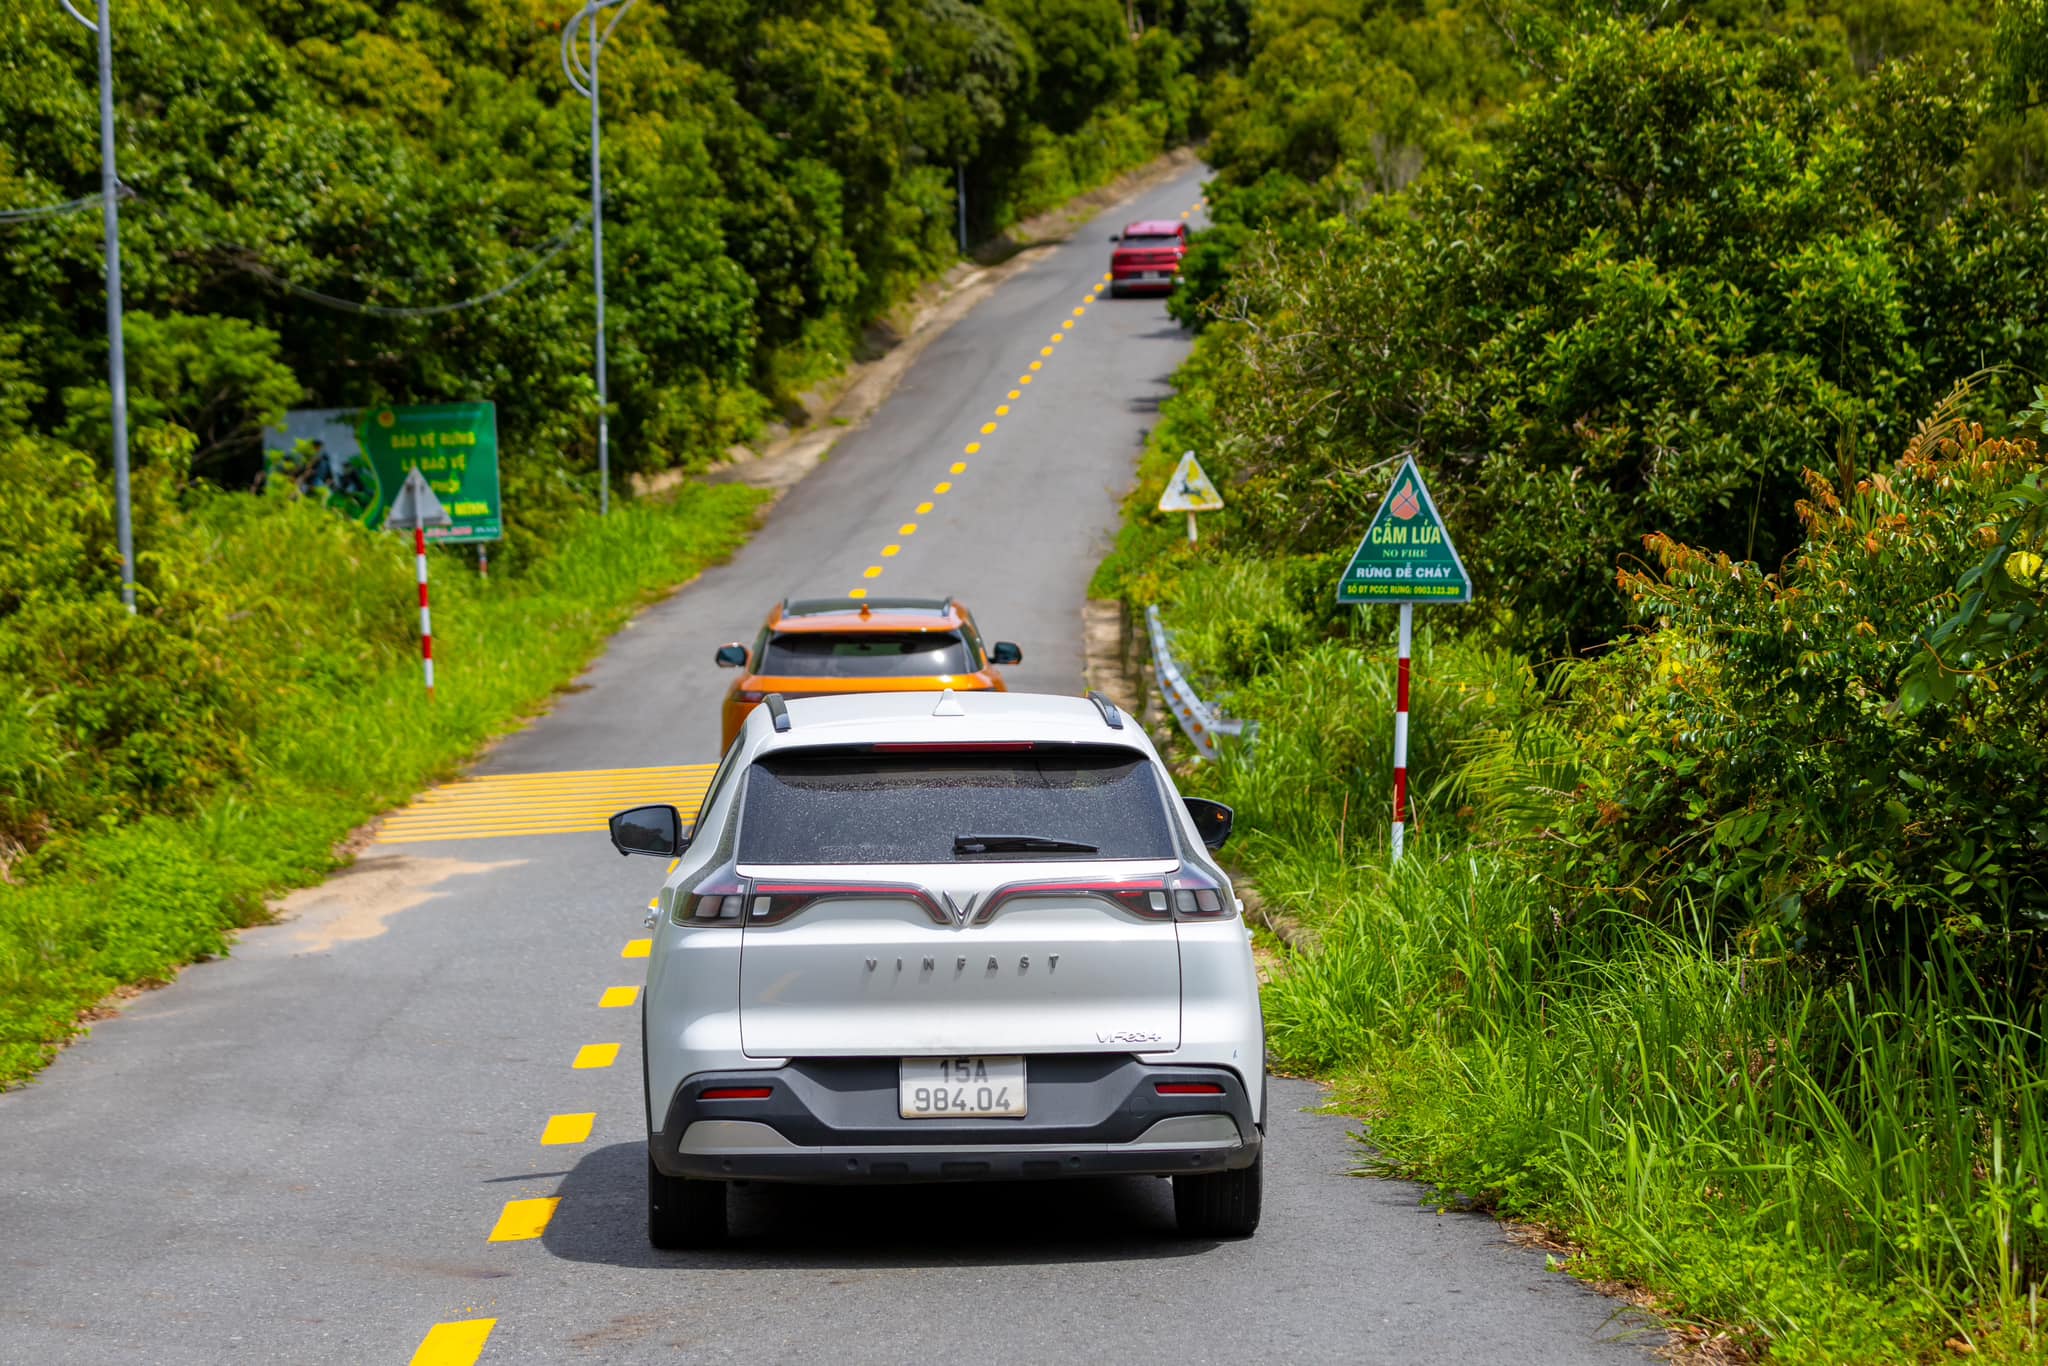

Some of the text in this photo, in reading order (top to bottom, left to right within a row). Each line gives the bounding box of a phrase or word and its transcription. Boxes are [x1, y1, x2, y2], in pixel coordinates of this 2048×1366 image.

[1372, 518, 1441, 544] CẤM LỬA
[1382, 549, 1427, 558] NO FIRE
[1356, 564, 1392, 578] RỪNG
[1415, 564, 1451, 578] CHÁY
[1369, 585, 1388, 594] PCCC
[866, 955, 1059, 972] VINFAST
[939, 1059, 988, 1083] 15A
[914, 1087, 1010, 1112] 984.04
